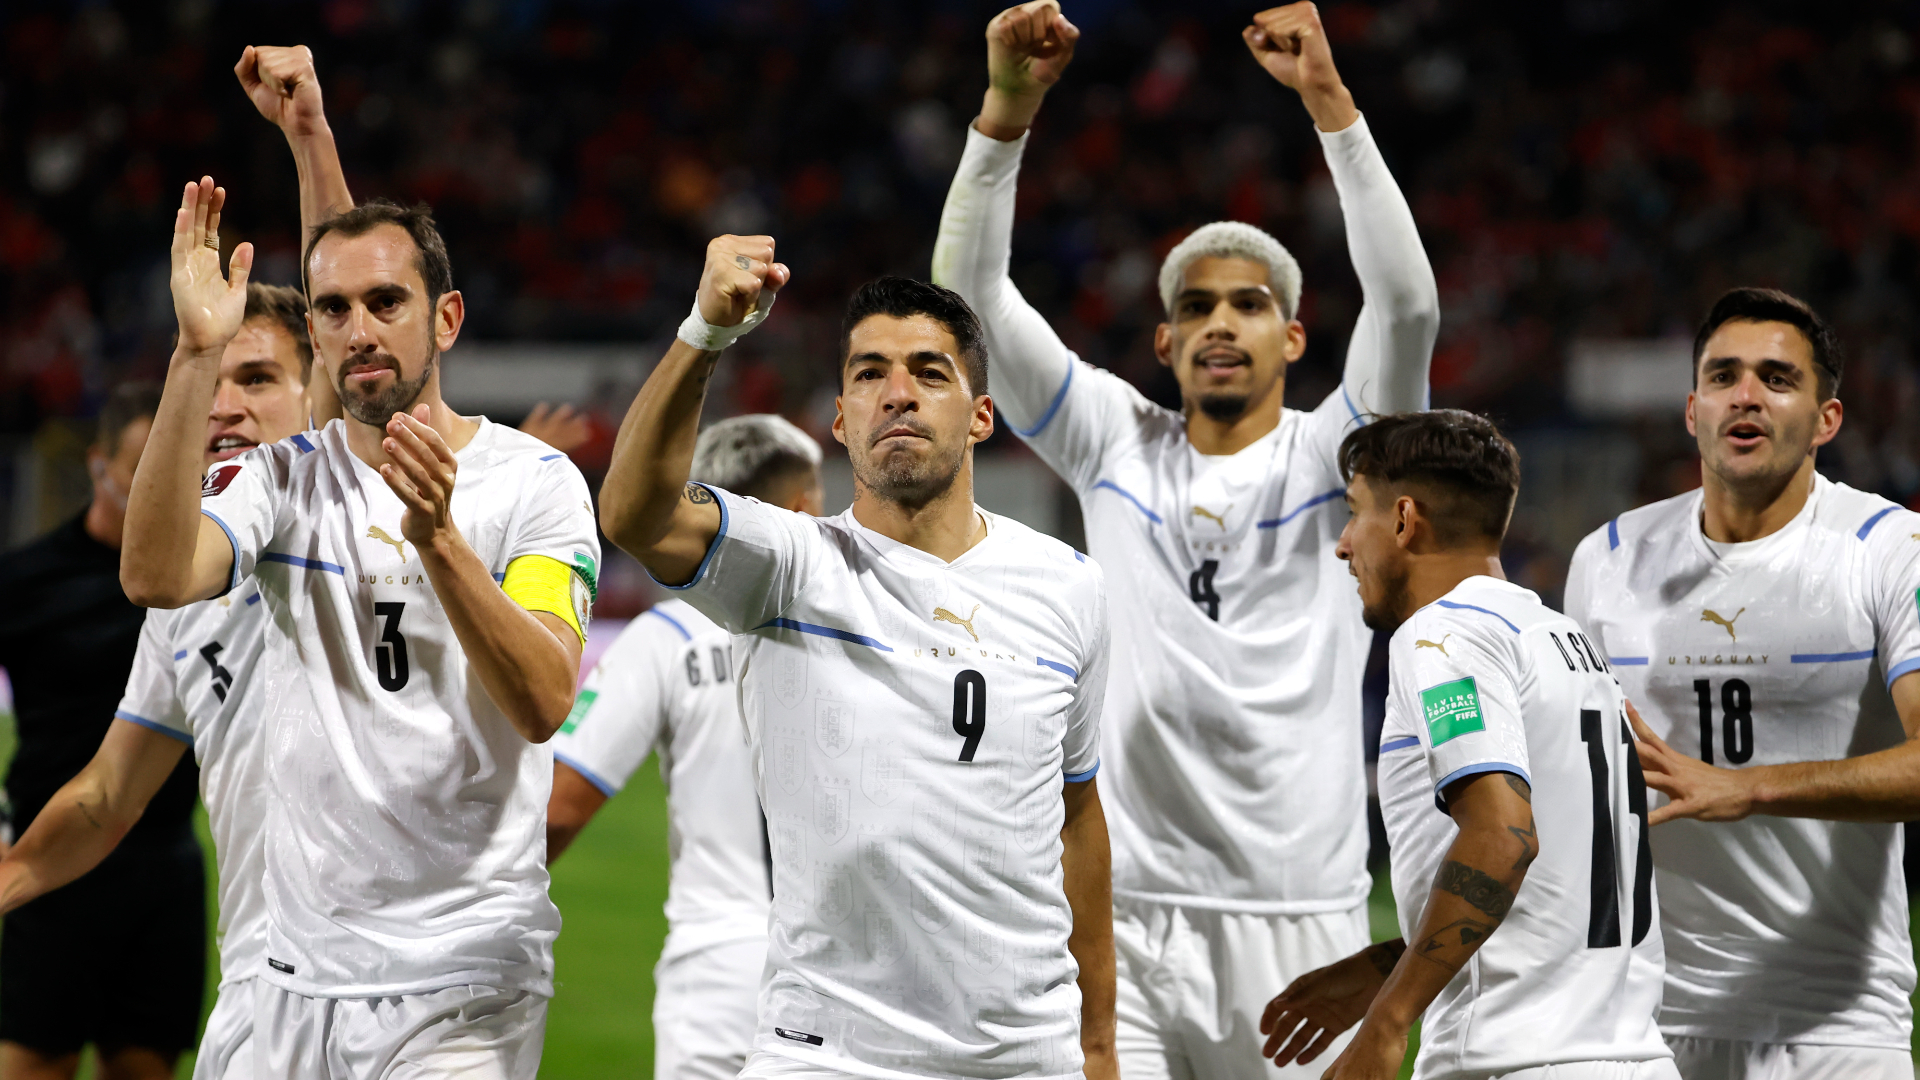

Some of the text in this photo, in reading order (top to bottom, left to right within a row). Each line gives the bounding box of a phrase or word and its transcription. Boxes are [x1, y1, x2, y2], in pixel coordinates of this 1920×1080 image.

[358, 574, 424, 585] UUGUA
[1189, 559, 1221, 622] 4
[375, 602, 409, 692] 3
[914, 647, 1016, 661] URUUAY
[1668, 654, 1769, 665] URUGUAY
[200, 641, 233, 705] 5
[1426, 693, 1474, 712] LIVING
[1428, 700, 1475, 719] FOOTBALL
[952, 669, 986, 763] 9
[1455, 710, 1478, 721] FIFA
[1693, 678, 1754, 765] 18
